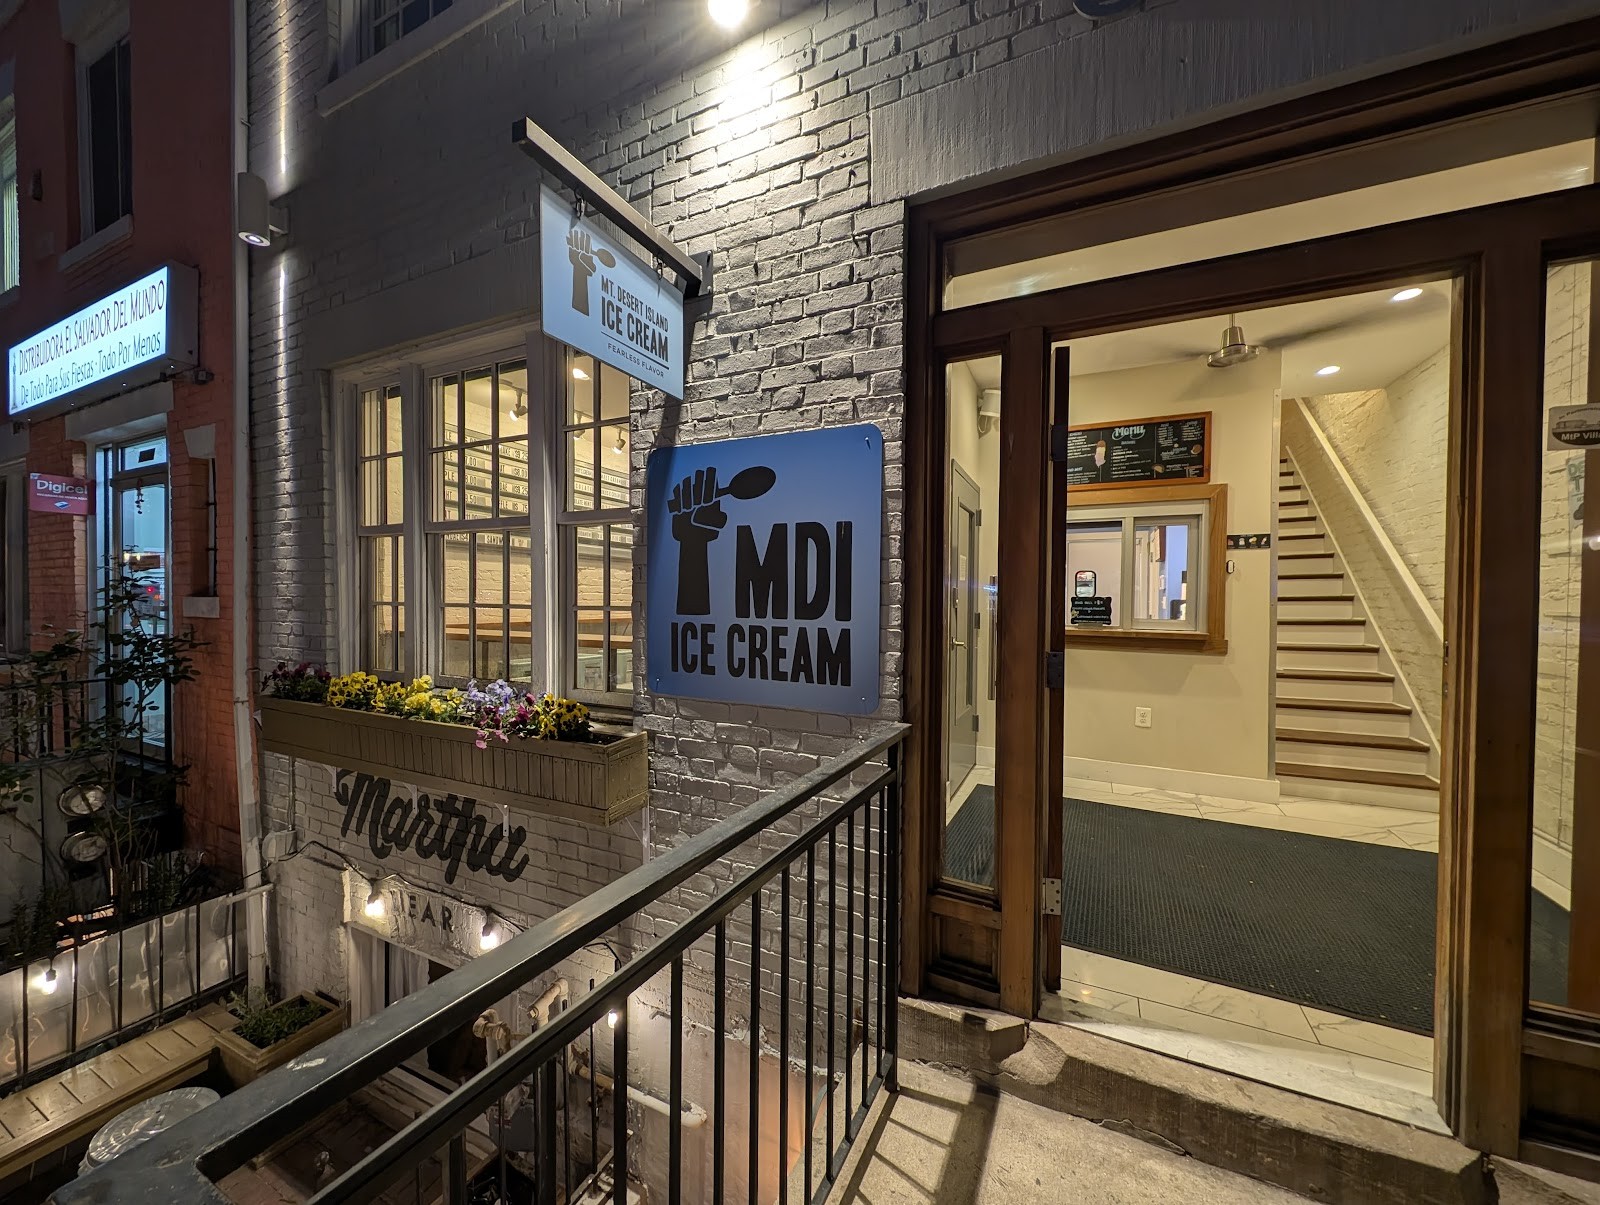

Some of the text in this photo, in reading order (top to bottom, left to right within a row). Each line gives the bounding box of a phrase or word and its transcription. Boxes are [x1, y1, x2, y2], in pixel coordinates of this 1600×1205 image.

[19, 331, 65, 376] DISTRIBUIDORA
[74, 307, 112, 350] SALVADOR
[113, 299, 128, 332] DEL
[130, 279, 165, 325] MUNDO
[601, 274, 668, 333] MT. DESERT ISLAND
[601, 296, 669, 363] ICE CREAM
[21, 332, 161, 405] De Todo Para Sus Fiestas Todo Por Menos
[607, 342, 665, 379] FEARLESS FLAVOR
[36, 479, 88, 495] Digicel
[735, 520, 853, 622] MDI
[670, 621, 851, 687] ICE CREAM
[334, 769, 530, 885] Martha
